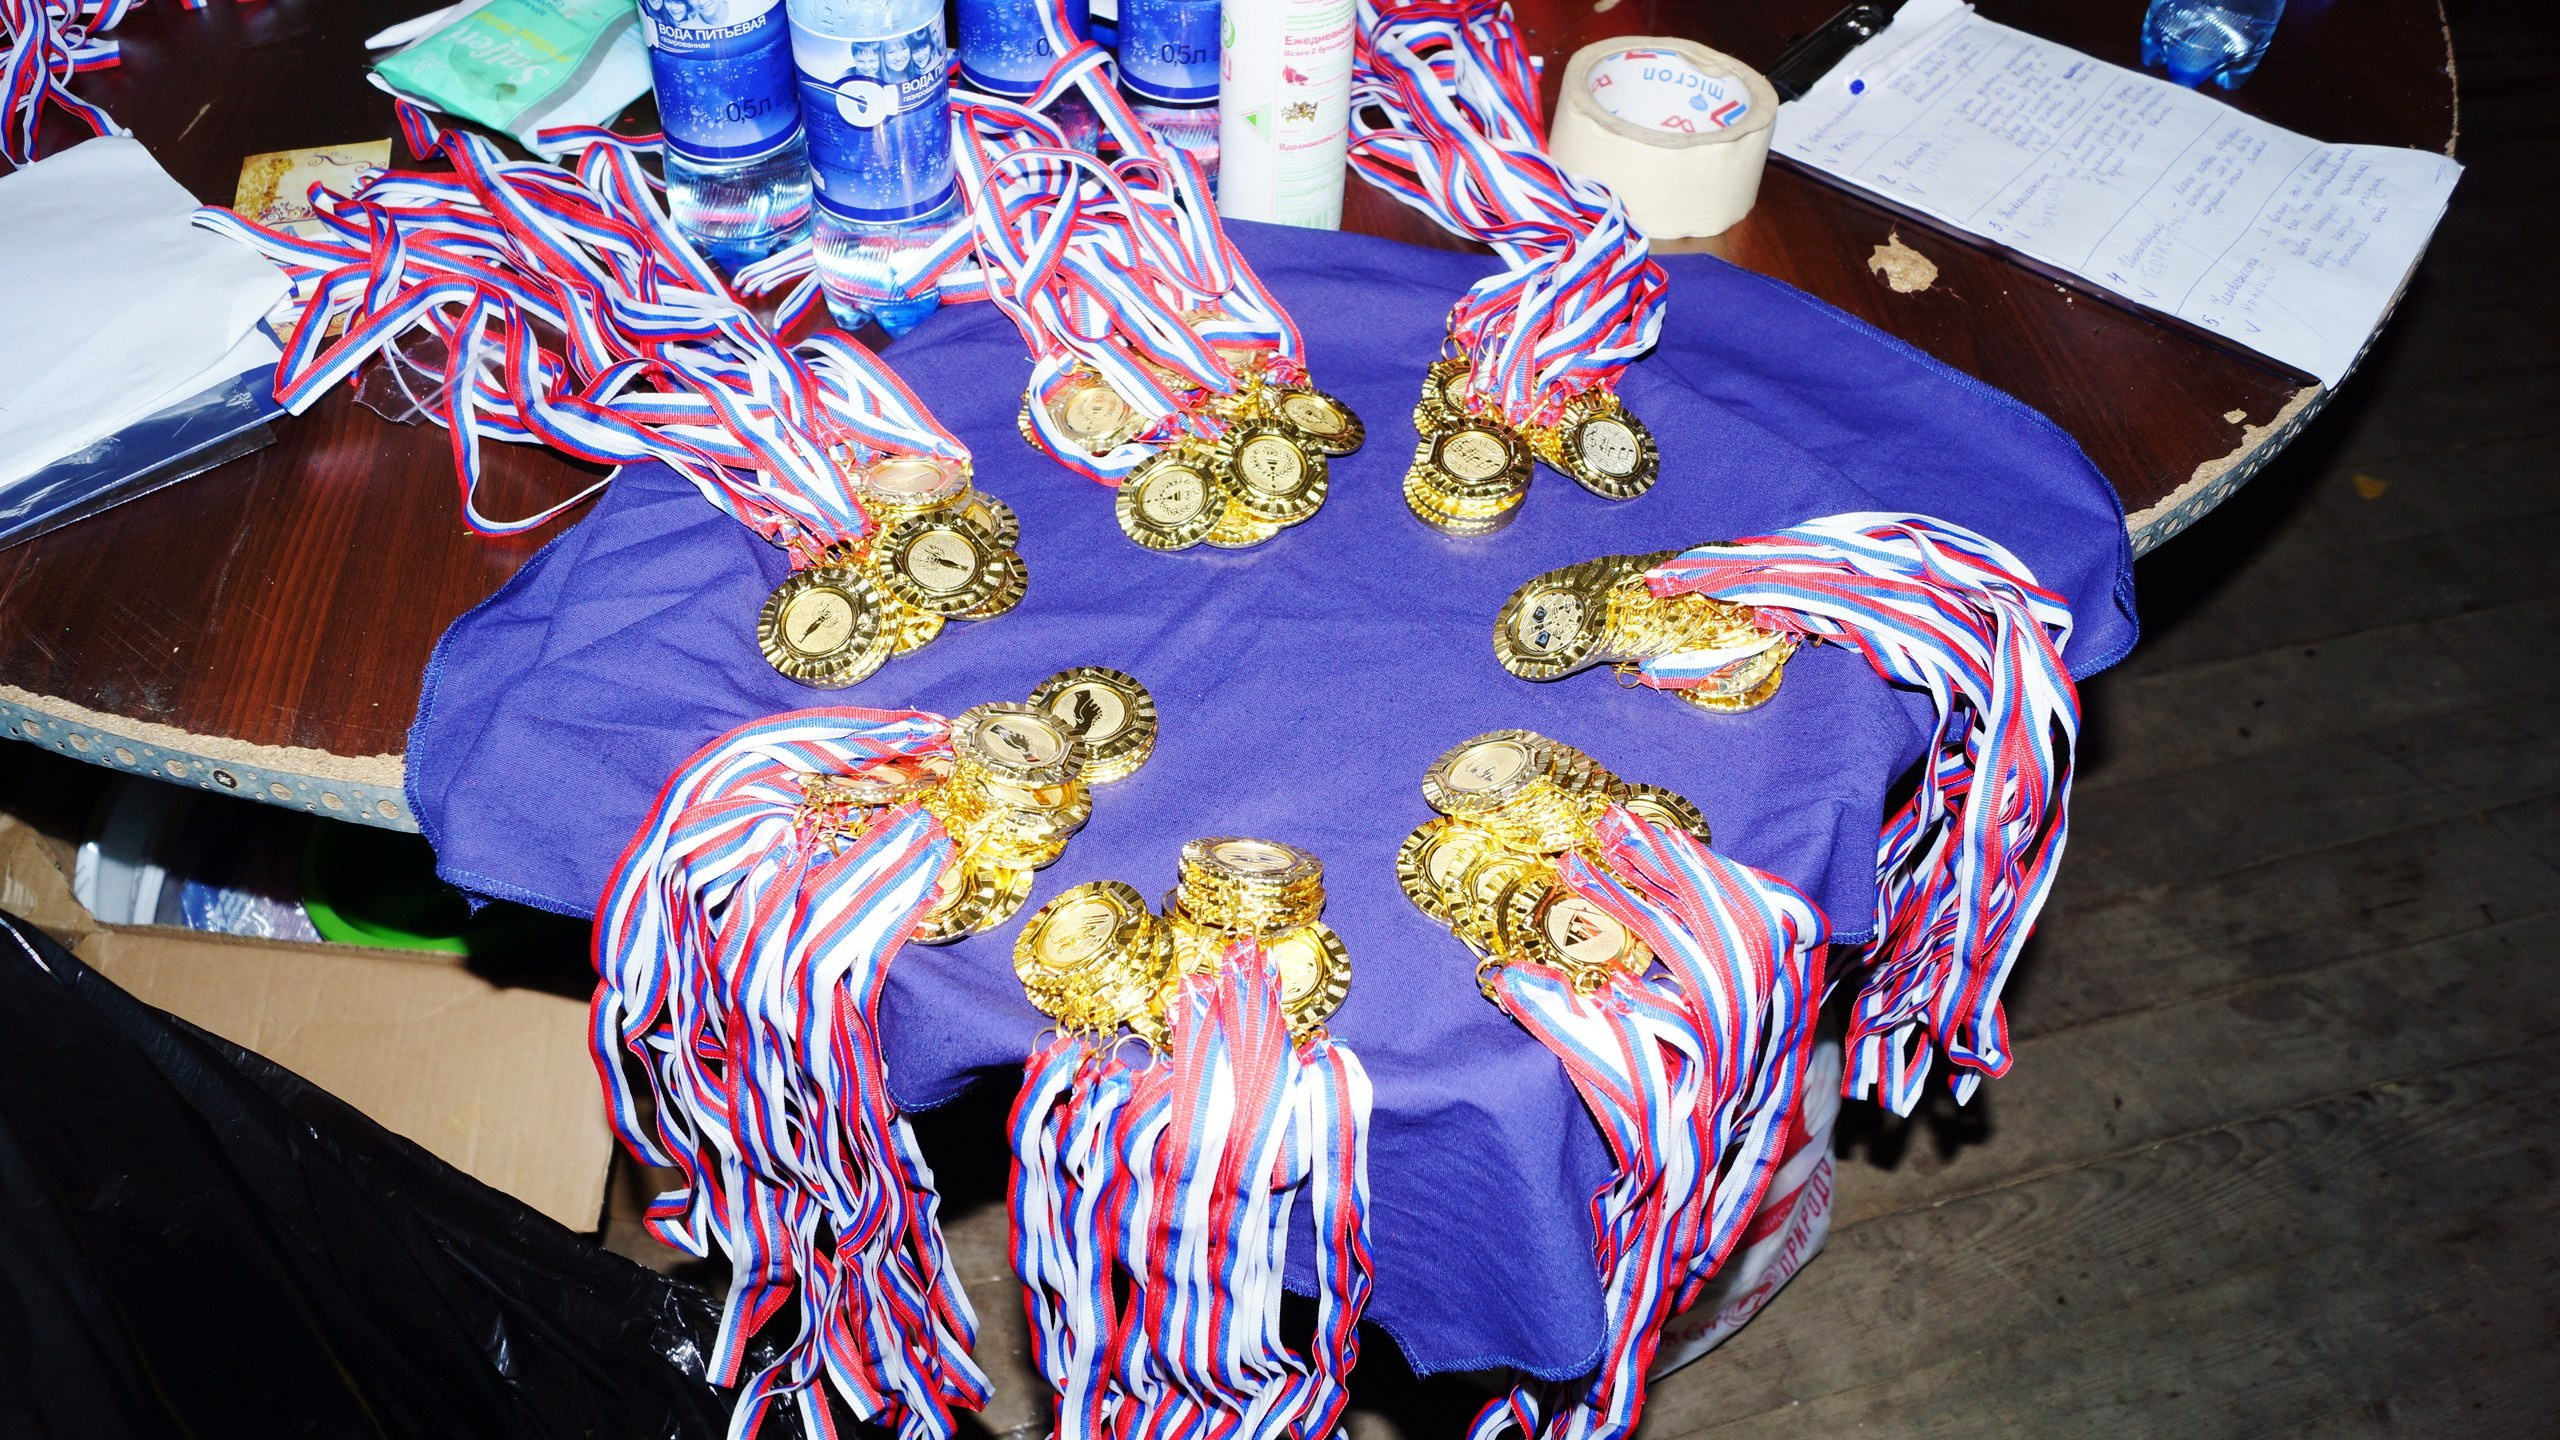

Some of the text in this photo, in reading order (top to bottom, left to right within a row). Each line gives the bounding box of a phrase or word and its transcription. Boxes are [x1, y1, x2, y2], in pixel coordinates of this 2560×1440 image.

[658, 15, 767, 41] ВОДА ПИТЬЕВАЯ
[1161, 44, 1207, 67] 0,5л
[902, 72, 934, 94] ВОДА
[1643, 67, 1725, 101] micron
[726, 98, 771, 124] 0,5л
